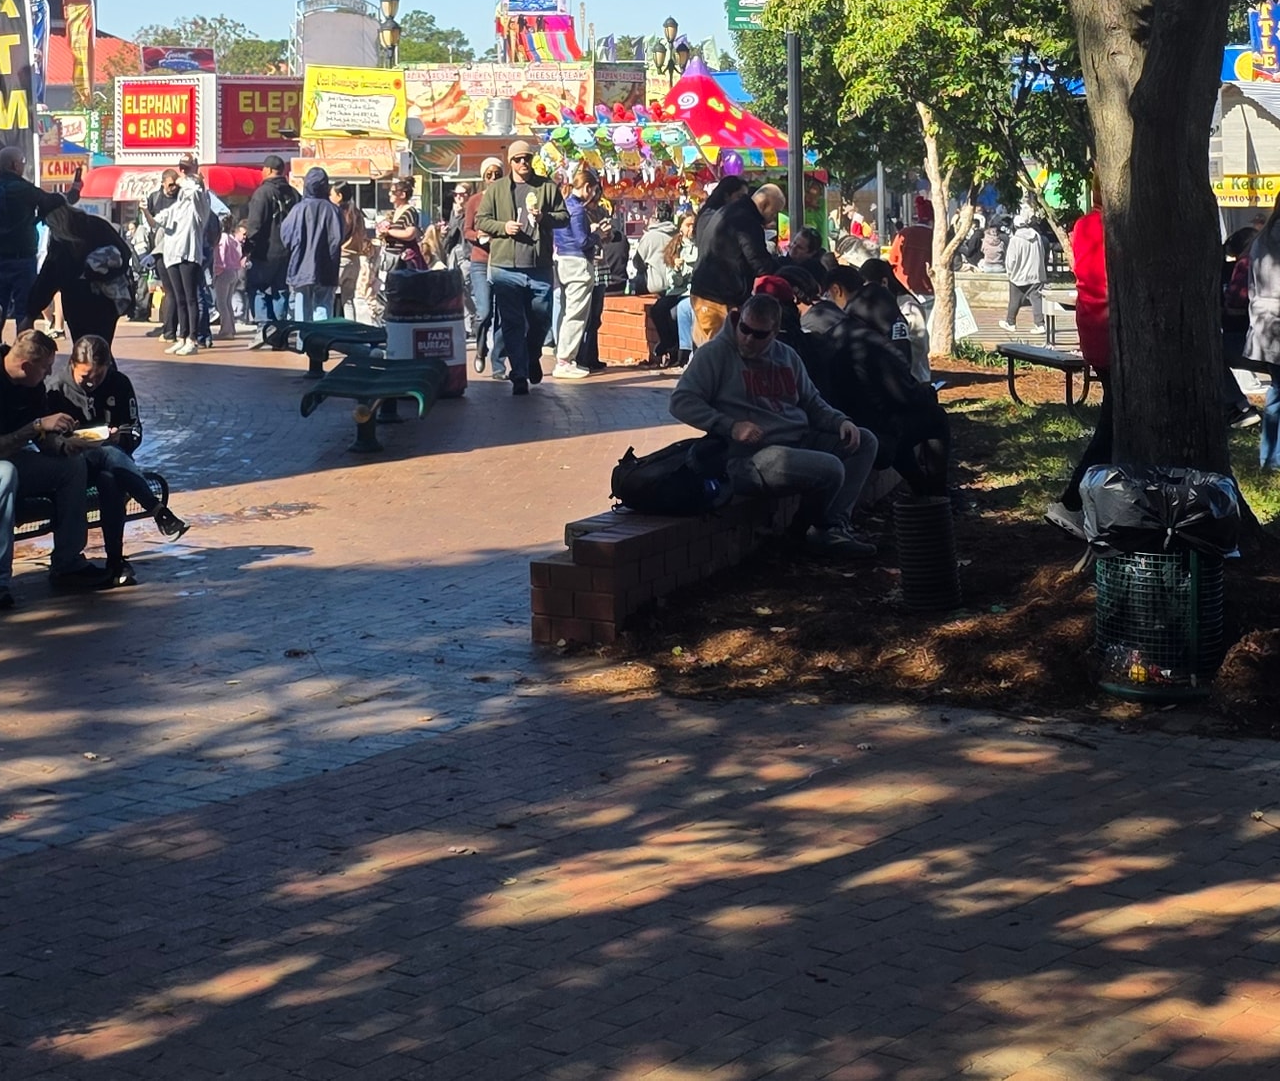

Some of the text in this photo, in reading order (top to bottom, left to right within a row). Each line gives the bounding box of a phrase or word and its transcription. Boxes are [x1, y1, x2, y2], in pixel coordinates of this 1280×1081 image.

[1257, 0, 1277, 68] TTLE
[124, 95, 189, 115] ELEPHANT
[238, 91, 303, 113] ELEP
[139, 118, 174, 139] EARS
[1231, 177, 1274, 190] Kettle
[417, 341, 451, 350] BUREAU
